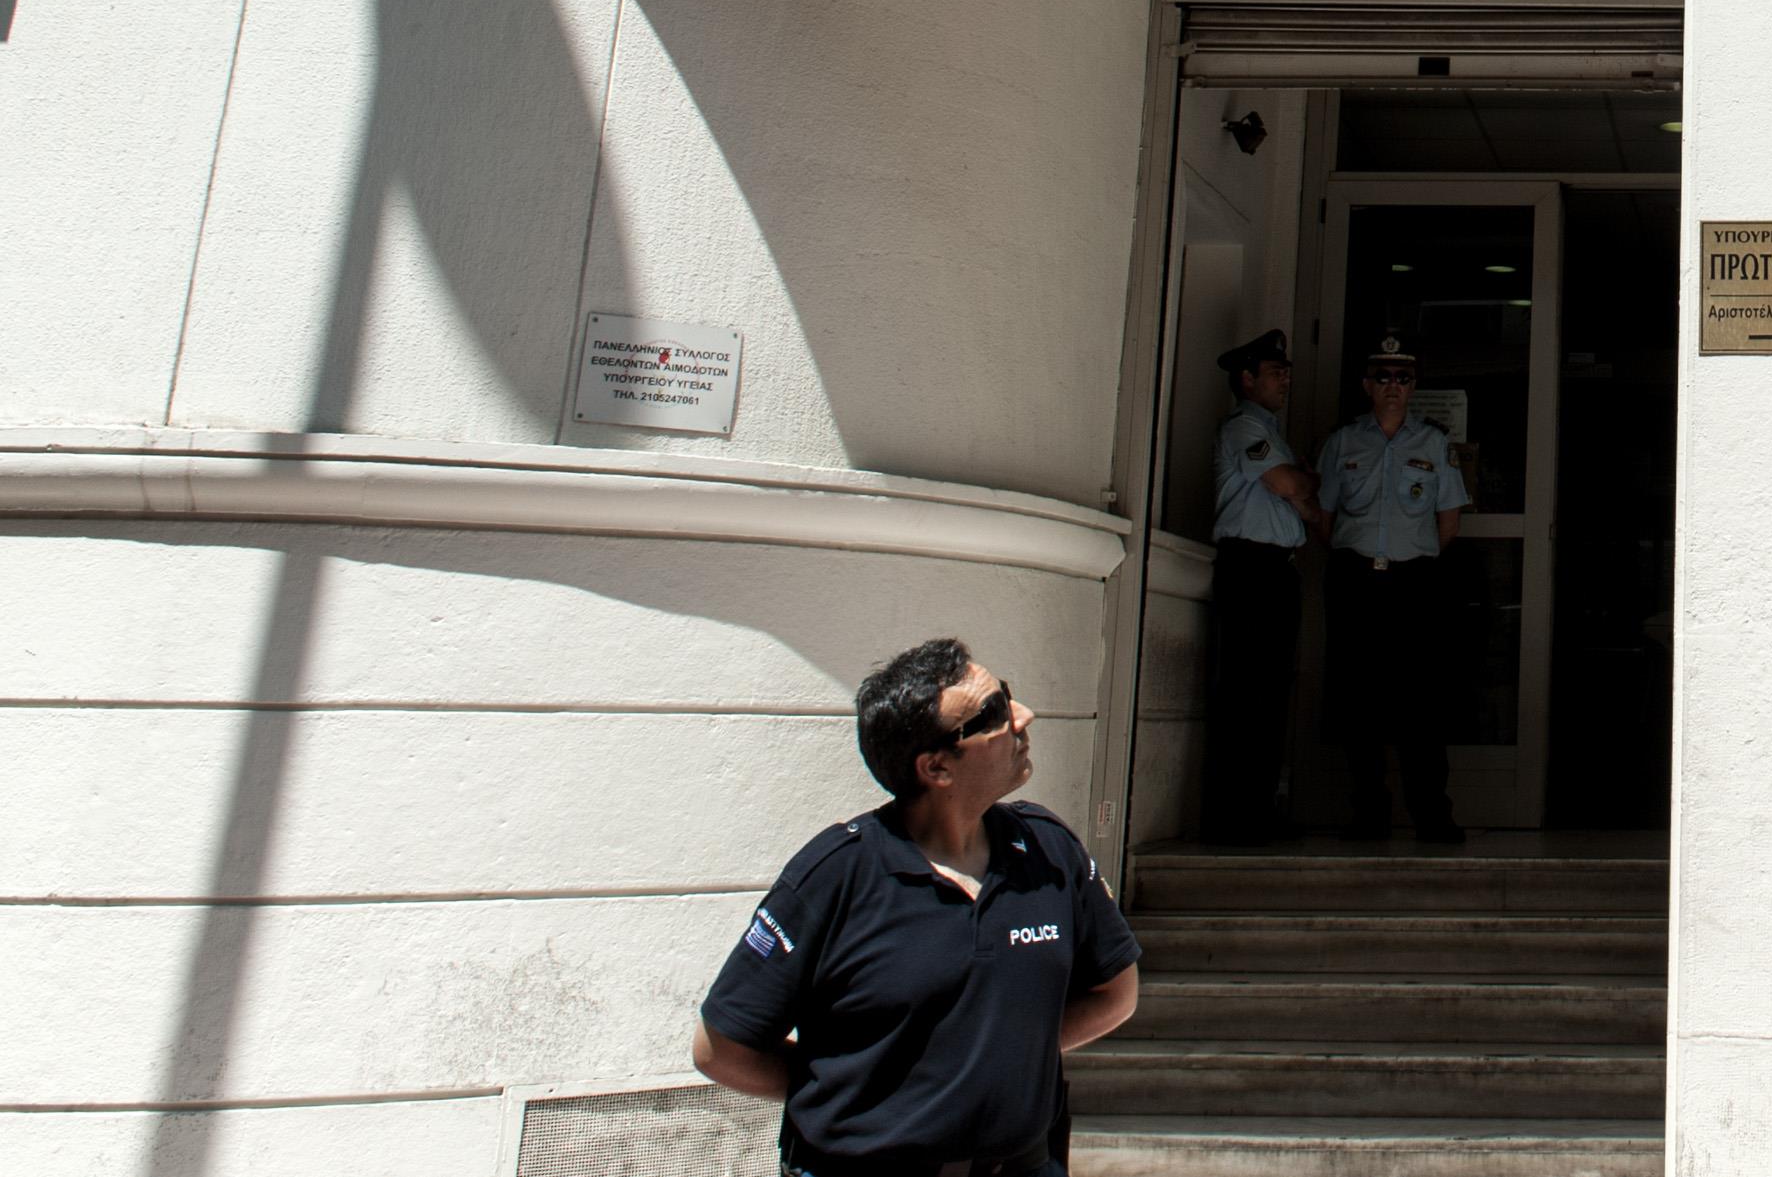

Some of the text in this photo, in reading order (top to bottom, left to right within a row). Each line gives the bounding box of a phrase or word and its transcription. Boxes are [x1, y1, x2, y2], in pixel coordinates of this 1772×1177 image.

[674, 348, 731, 362] ΣΥΛΛΟΓΟΣ
[591, 356, 729, 377] ΕΘΕΛΟΝΤΩΝ ΑΙΜΟΔΟΤΩΝ
[604, 372, 713, 391] ΥΠΟΥΡΓΕΙΟΥ ΥΓΕΙΑΣ
[613, 389, 638, 400] ΤΗΛ.
[1010, 924, 1060, 945] POLICE
